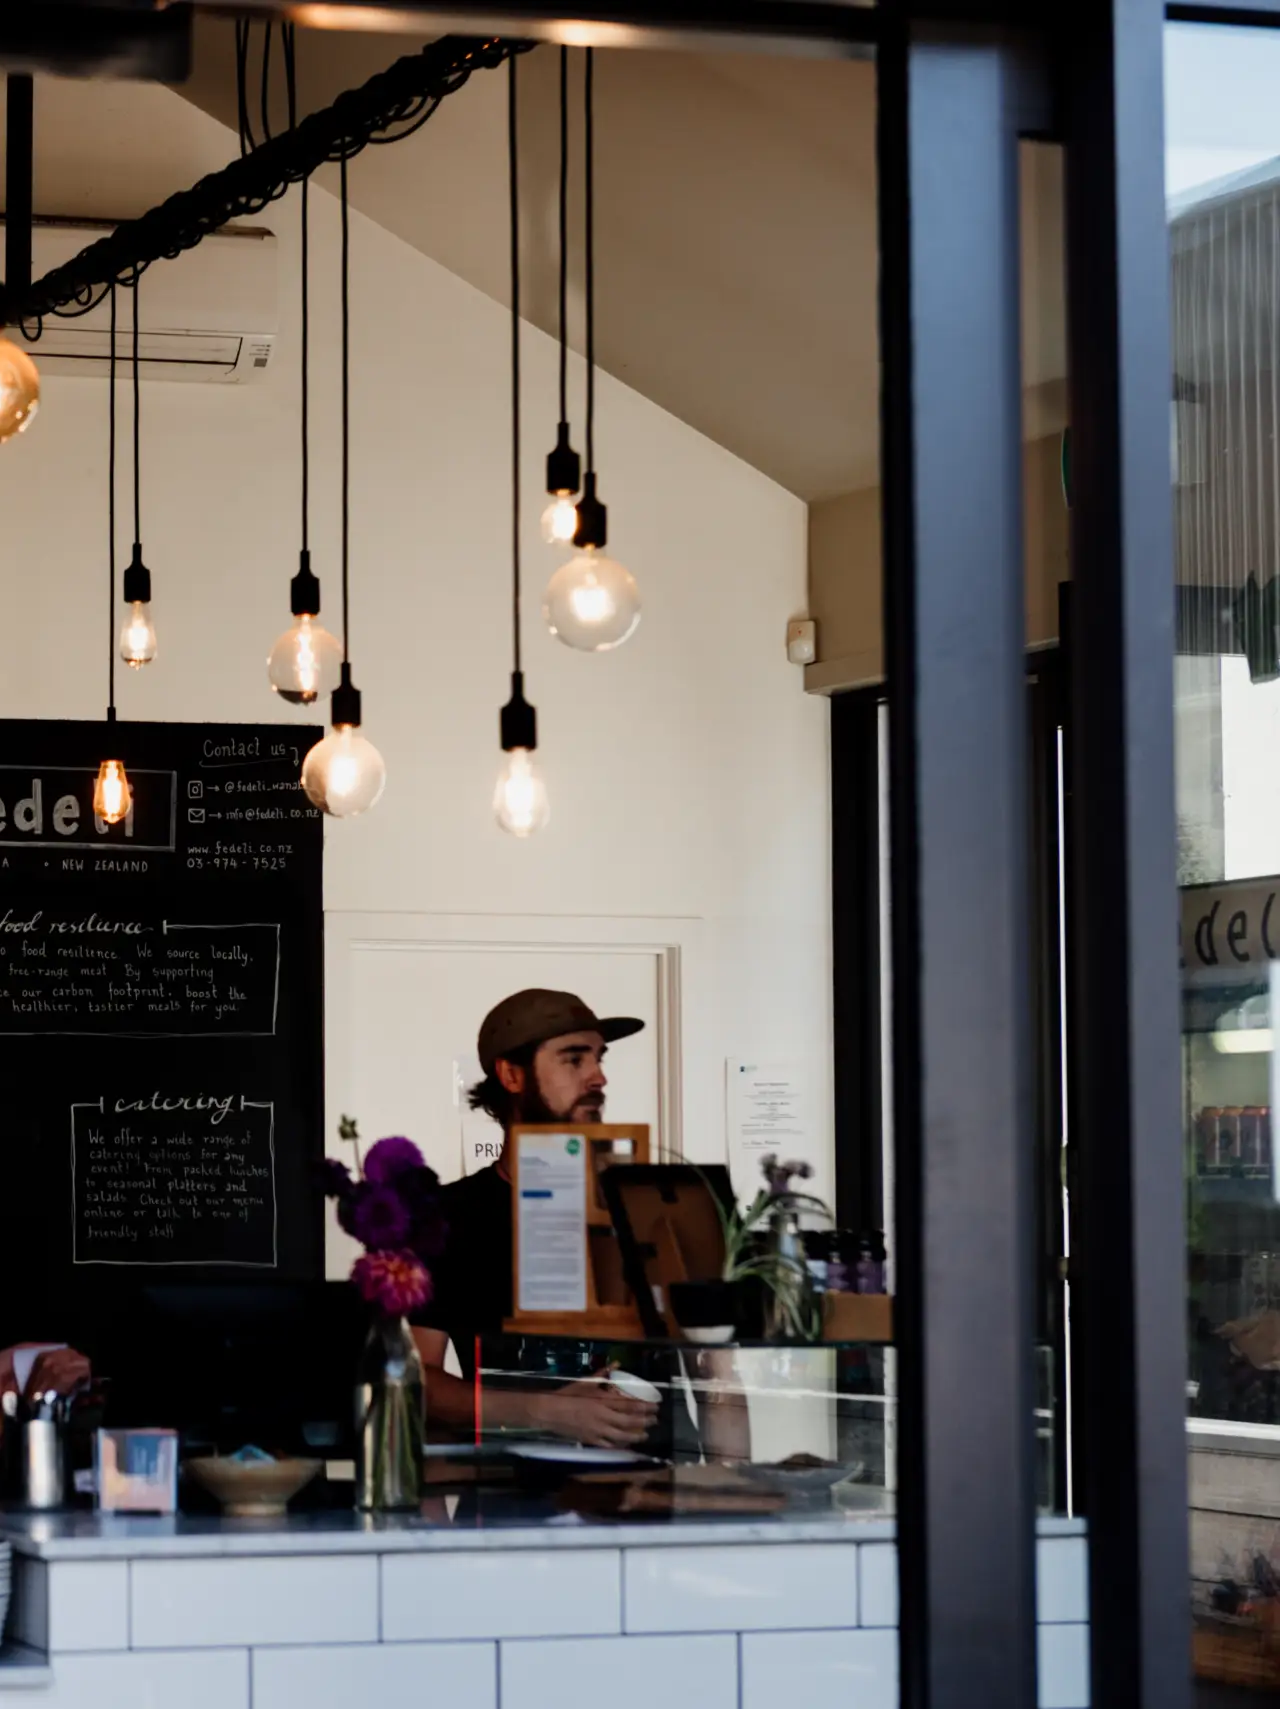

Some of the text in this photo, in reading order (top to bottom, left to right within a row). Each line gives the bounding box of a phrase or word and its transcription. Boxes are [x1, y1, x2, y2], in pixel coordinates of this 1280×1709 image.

[203, 737, 286, 757] Contact us
[62, 858, 84, 871] NEW
[94, 859, 148, 873] ZEALAND
[49, 913, 154, 934] resilience
[1177, 892, 1277, 968] del
[22, 940, 46, 958] food
[136, 941, 153, 958] We
[166, 948, 200, 960] source
[9, 962, 69, 980] free-range
[80, 963, 107, 976] meat
[124, 963, 141, 982] By
[153, 963, 214, 984] supporting
[22, 988, 42, 998] our
[52, 981, 94, 998] carbon
[185, 983, 218, 999] boost
[228, 984, 248, 1000] the
[88, 1000, 135, 1013] tastier
[148, 999, 182, 1012] meals
[190, 1000, 208, 1014] for
[114, 1091, 235, 1125] catering
[88, 1127, 253, 1149] We offer a wide range of
[89, 1147, 140, 1164] catering
[201, 1148, 219, 1160] for
[224, 1152, 245, 1166] any
[183, 1162, 223, 1178] packed
[84, 1177, 248, 1194] to seasonal platters and
[179, 1195, 199, 1206] out
